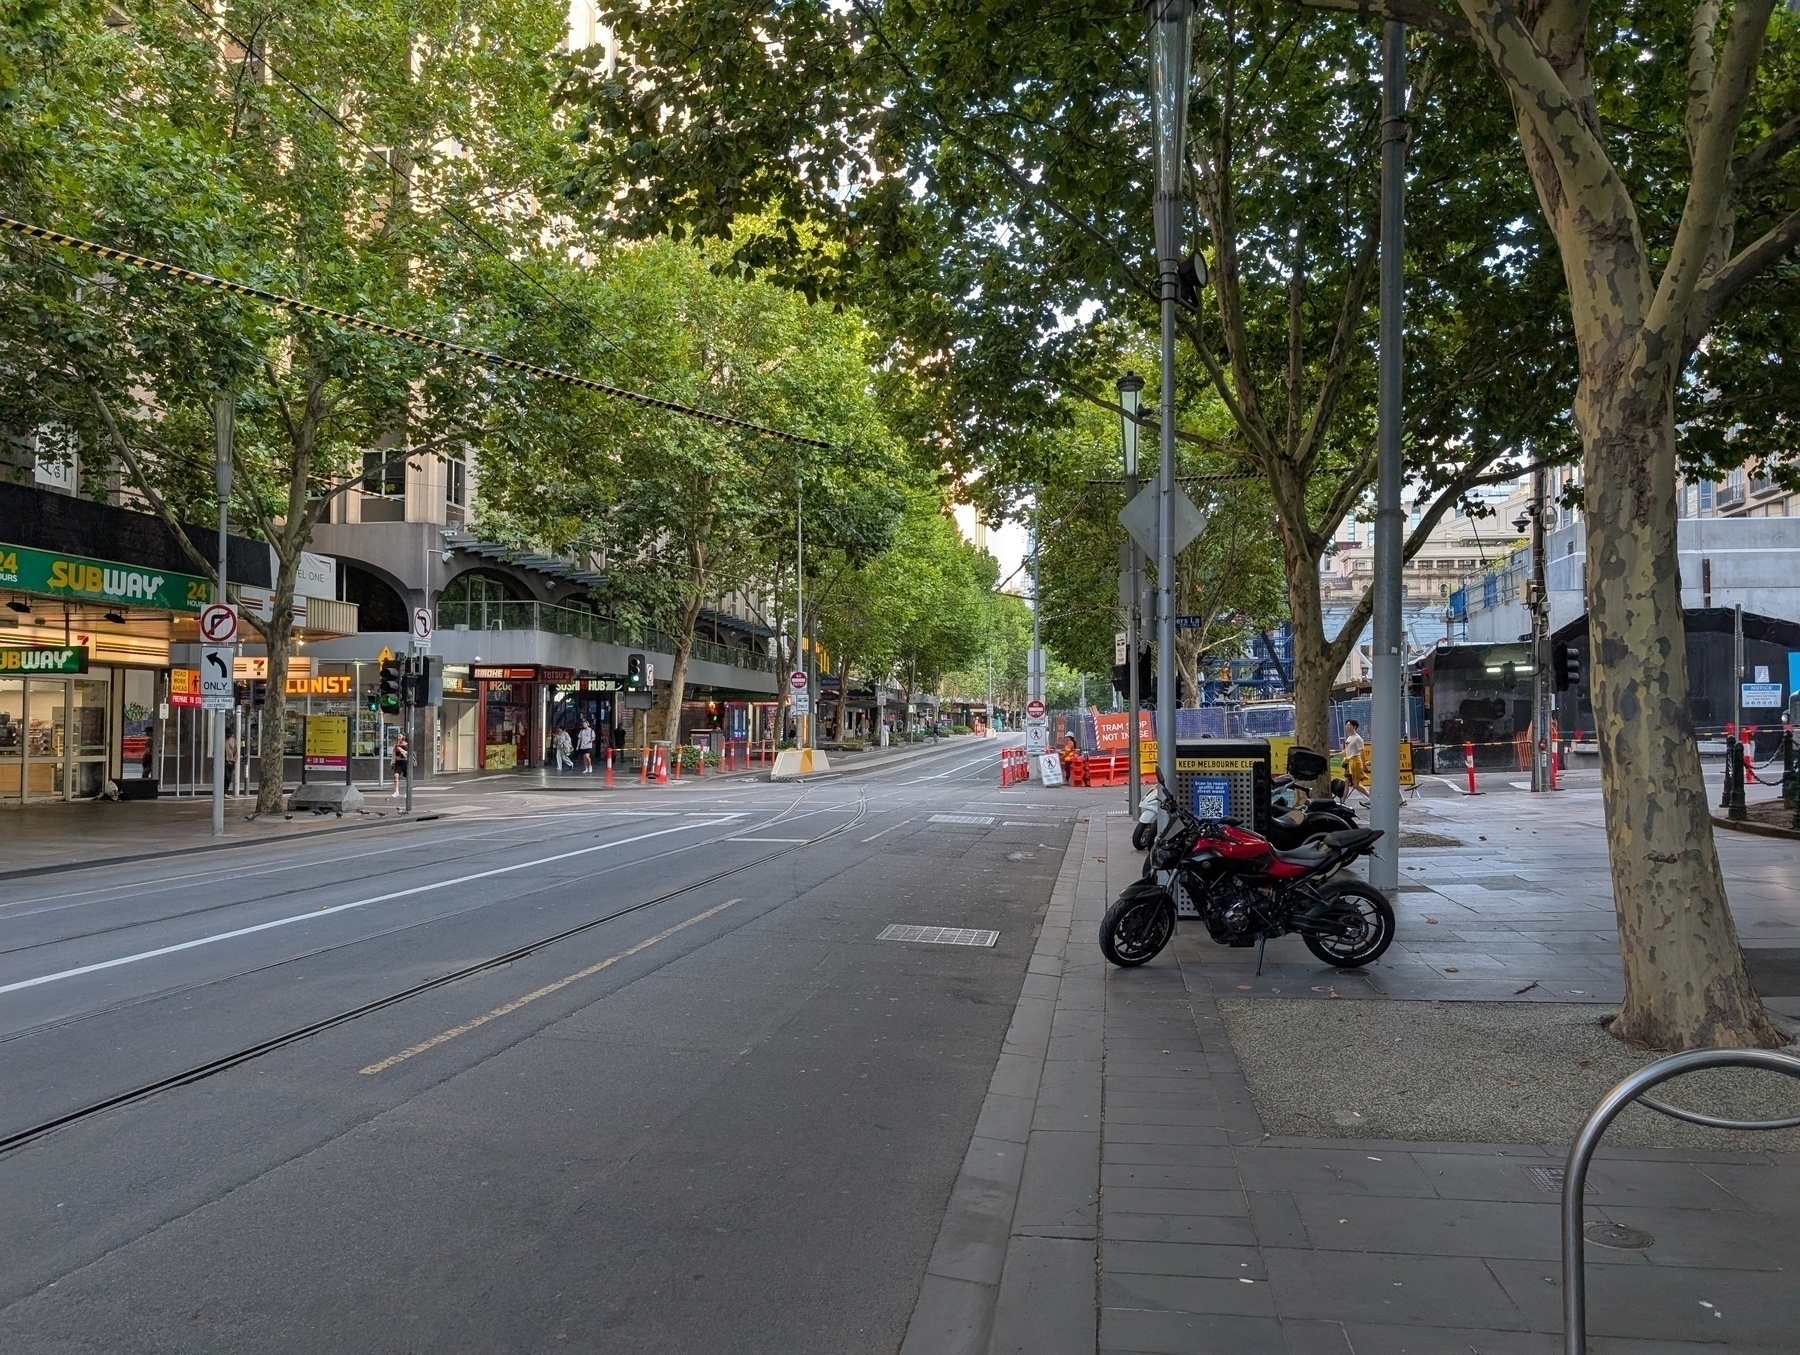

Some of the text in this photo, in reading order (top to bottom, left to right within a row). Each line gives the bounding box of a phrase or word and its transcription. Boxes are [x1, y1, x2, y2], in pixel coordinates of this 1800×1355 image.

[47, 561, 165, 600] SUBWAY
[308, 571, 325, 583] ONE
[187, 581, 207, 600] 24
[1175, 617, 1189, 625] ers
[0, 650, 74, 669] UBWAY
[203, 681, 228, 691] ONLY
[588, 680, 606, 691] HUB
[172, 695, 188, 703] PREPARE
[1101, 722, 1124, 732] TRAM
[1102, 733, 1119, 742] NOT
[1178, 760, 1254, 768] KEEP MELBOURNE CLE
